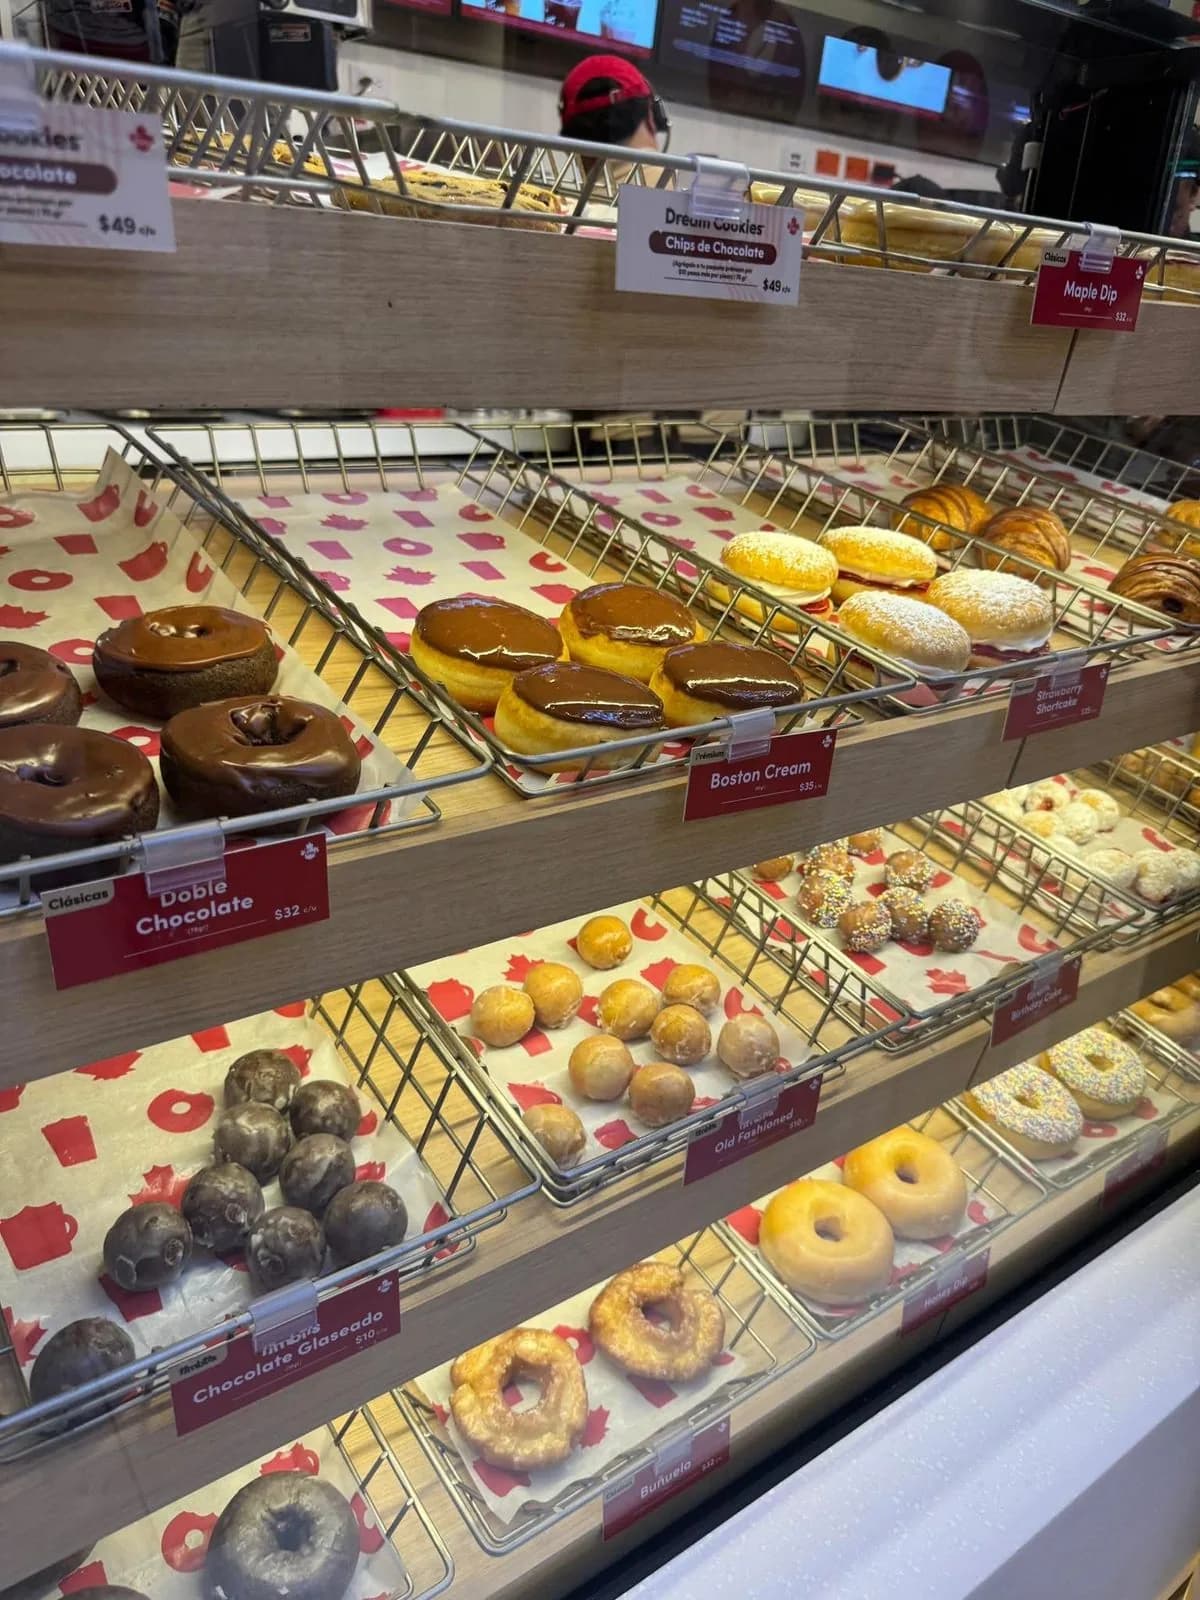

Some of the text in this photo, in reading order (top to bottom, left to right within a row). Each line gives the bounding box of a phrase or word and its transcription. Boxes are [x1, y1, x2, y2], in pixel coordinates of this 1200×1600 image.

[0, 163, 78, 185] ocolate
[99, 214, 136, 236] $49
[665, 207, 764, 236] Dream Cookies
[665, 236, 765, 258] Chips de Chocolate
[763, 277, 781, 293] $49
[1064, 280, 1118, 307] Maple Dip
[710, 761, 812, 790] Boston Cream
[800, 780, 814, 793] $35
[49, 888, 109, 911] Clásicas
[160, 879, 228, 908] Doble
[136, 895, 254, 935] Chocolate
[275, 904, 300, 921] $32
[714, 1136, 736, 1154] Old
[738, 1108, 794, 1143] Fashioned
[356, 1329, 376, 1345] $10
[192, 1311, 384, 1404] Chocolate Glaseado
